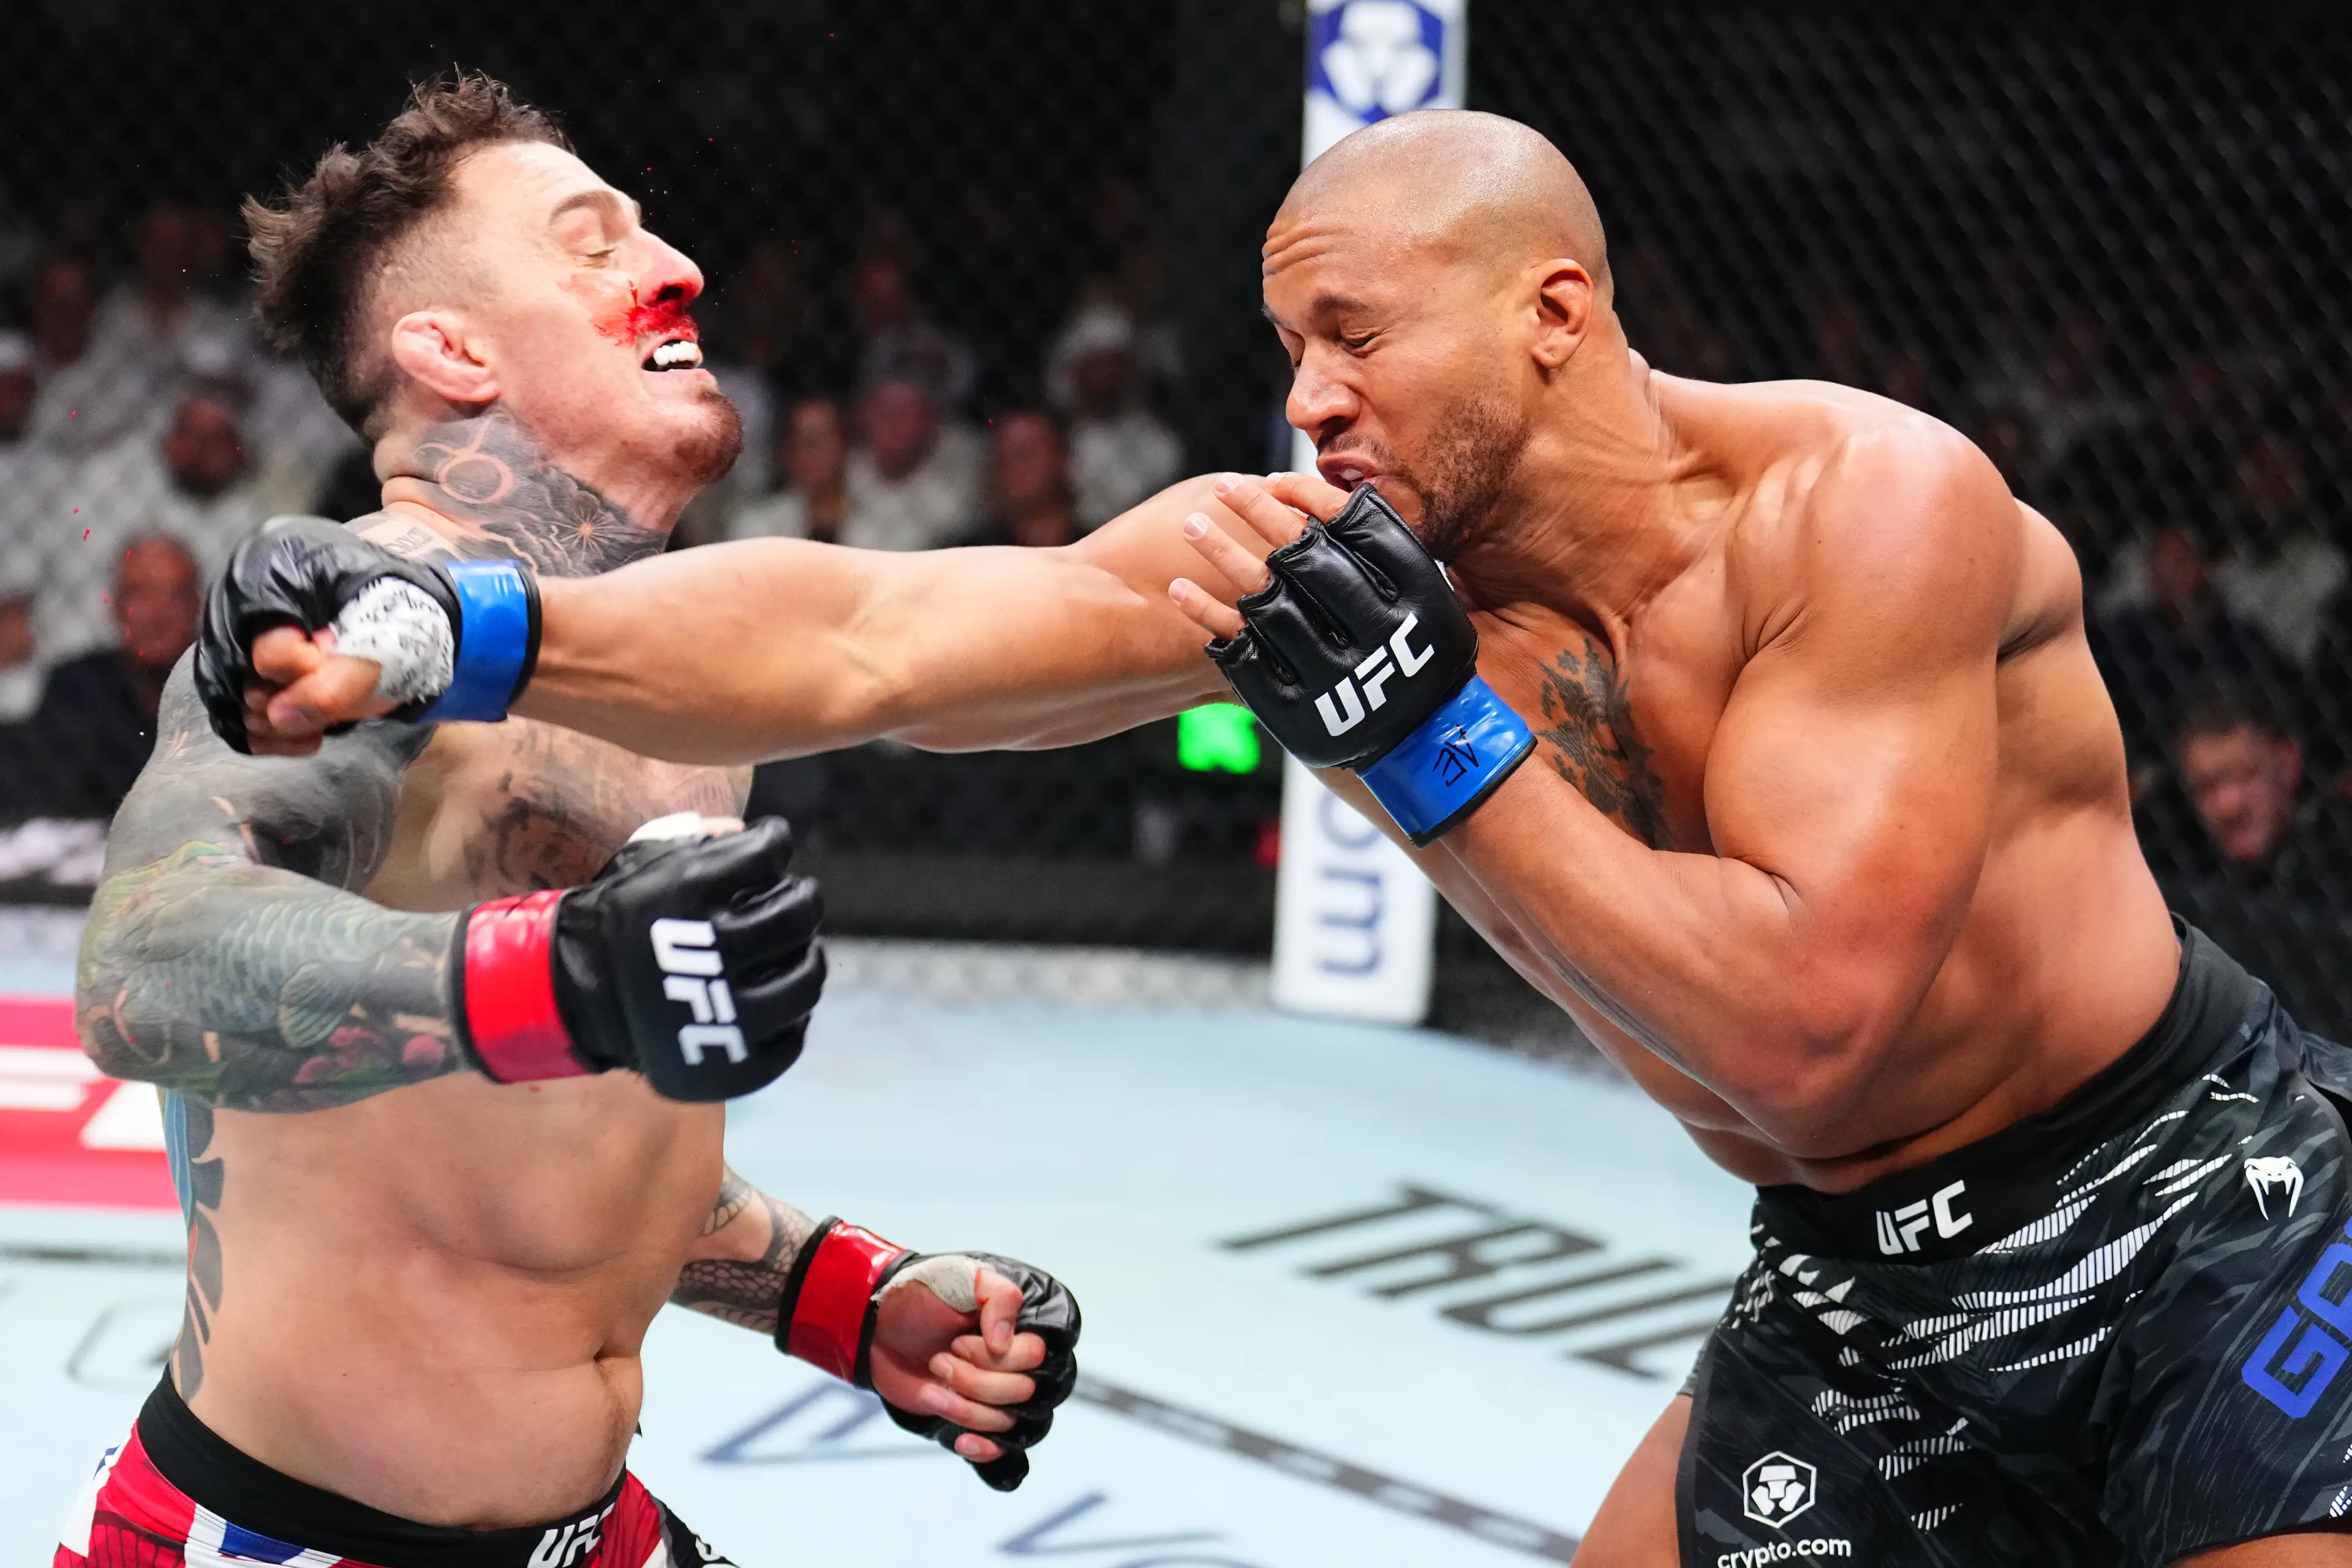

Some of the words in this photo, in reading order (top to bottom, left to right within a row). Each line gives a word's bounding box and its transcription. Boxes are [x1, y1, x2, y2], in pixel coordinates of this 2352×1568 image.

[1314, 612, 1434, 736] UFC
[650, 918, 748, 1066] UFC
[1875, 1179, 1973, 1255] UFC
[1717, 1539, 1852, 1568] crypto.com
